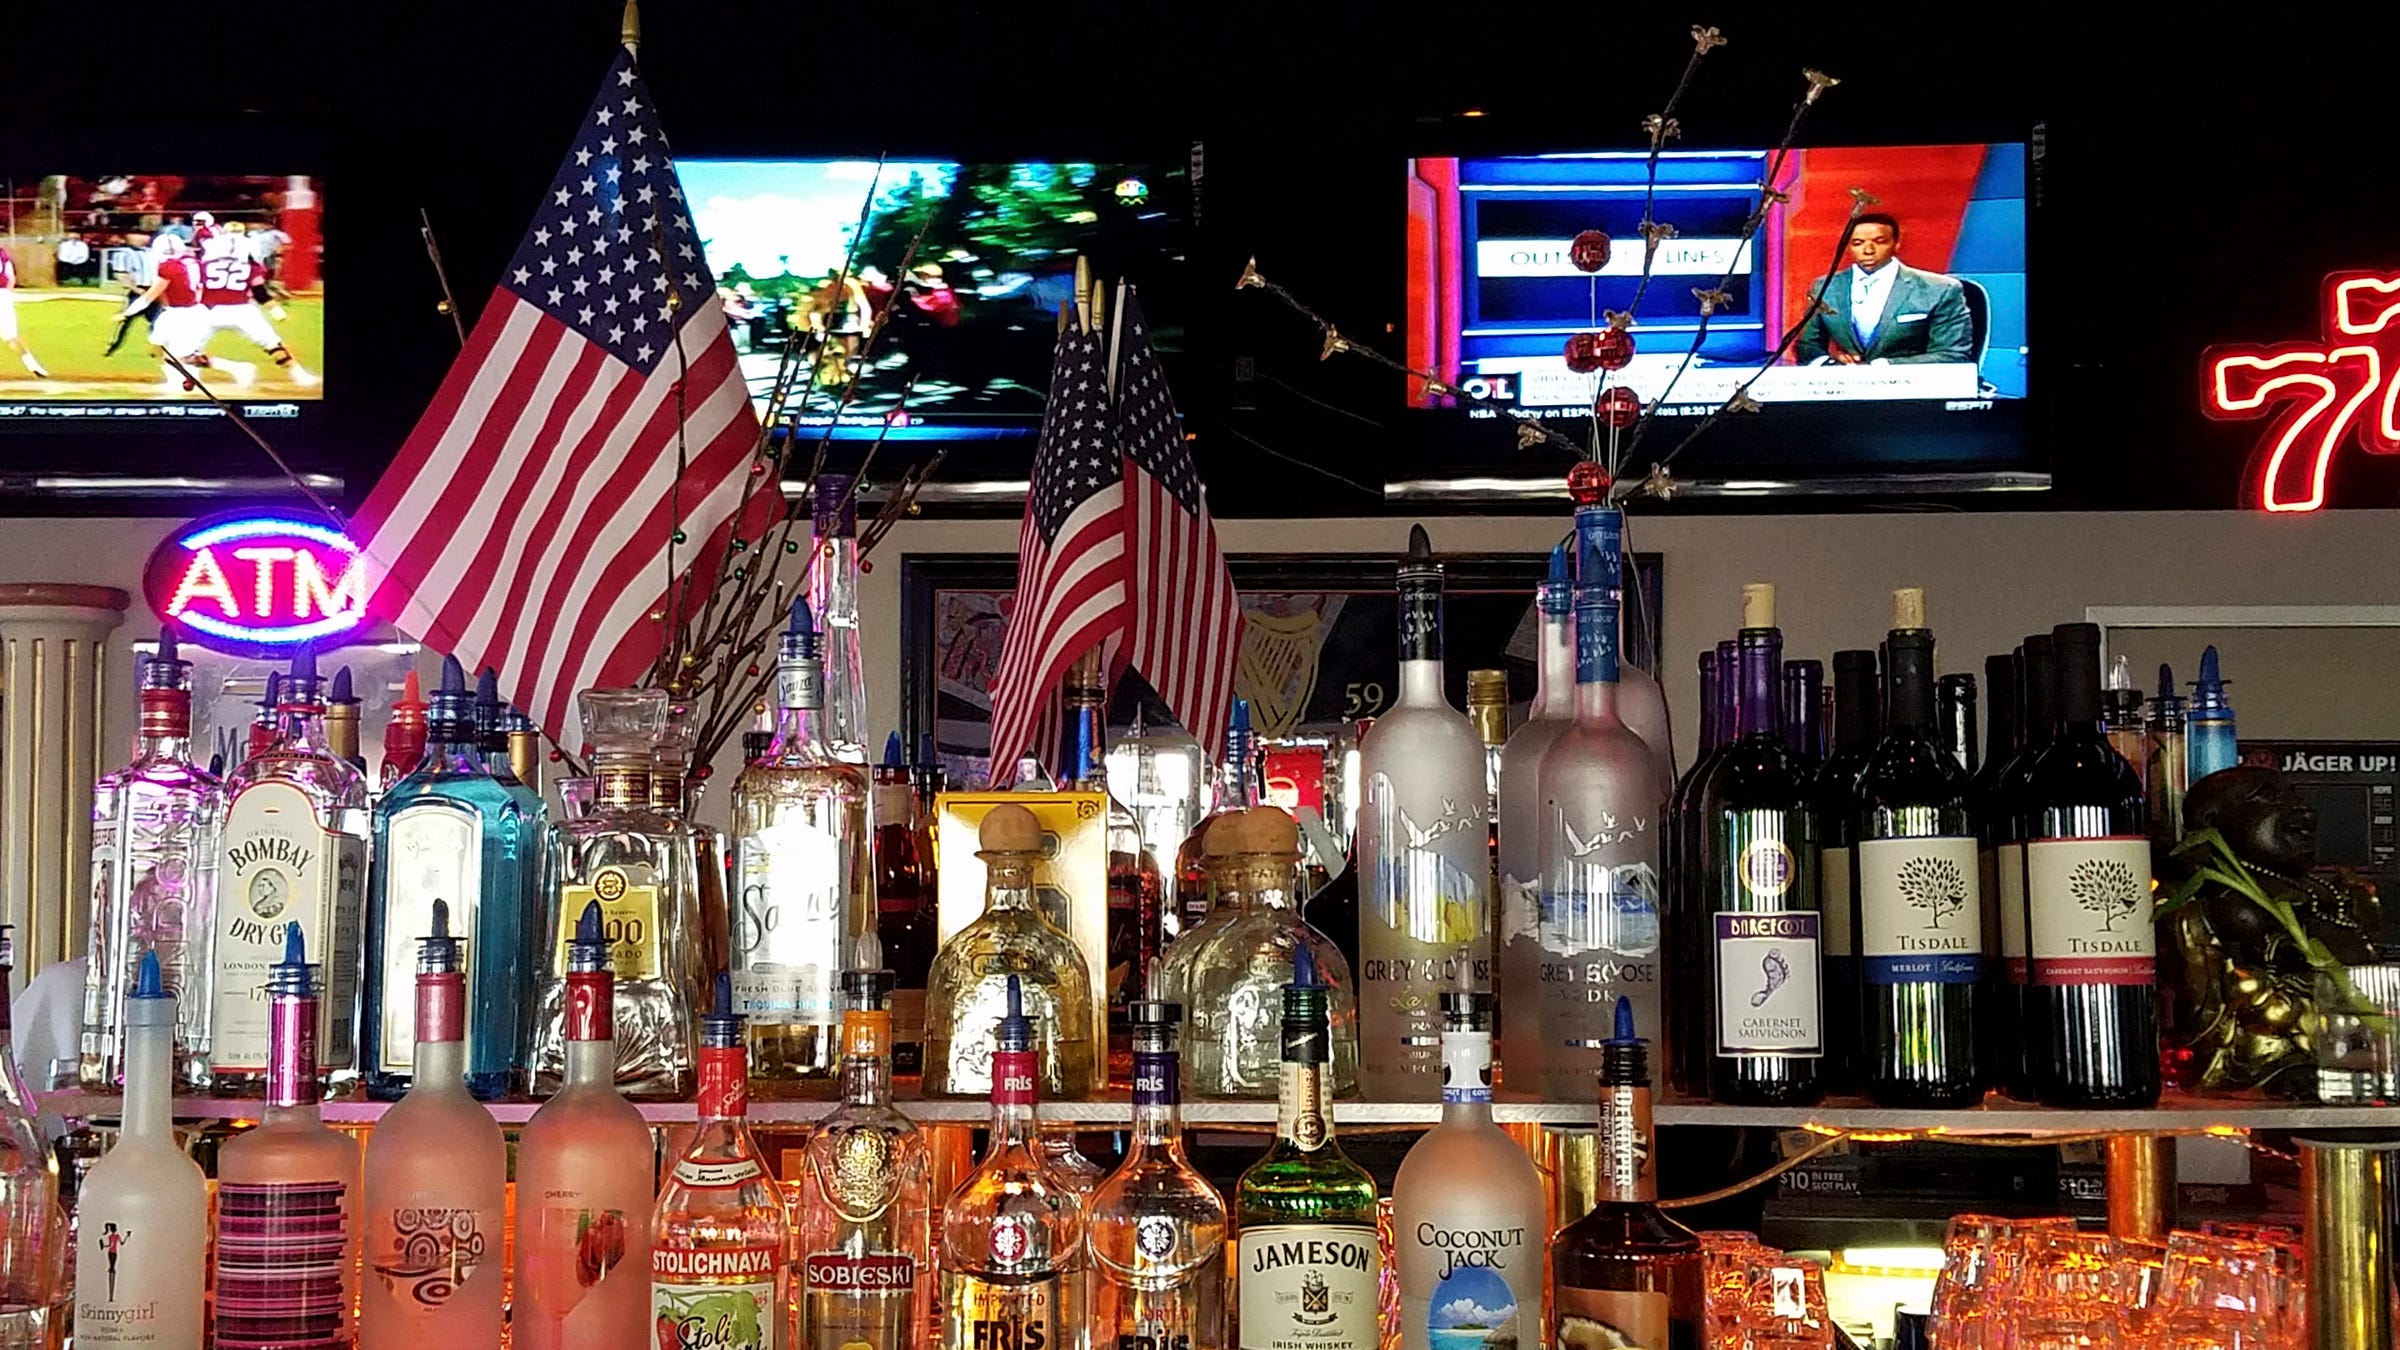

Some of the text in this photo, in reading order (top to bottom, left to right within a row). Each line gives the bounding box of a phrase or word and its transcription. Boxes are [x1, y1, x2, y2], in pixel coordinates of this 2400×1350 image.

[1665, 250, 1724, 264] LINES
[205, 261, 250, 291] 52
[1469, 408, 1498, 420] NBA
[1545, 407, 1560, 418] on
[1944, 400, 1994, 411] ESPN
[164, 547, 367, 618] ATM
[1343, 683, 1384, 715] 59
[2281, 751, 2397, 773] JÄGER UP!
[227, 837, 316, 877] BOMBAY
[228, 917, 268, 946] DRY
[1731, 918, 1808, 936] BAREFOOT
[223, 962, 266, 971] LONDON
[1365, 959, 1416, 982] GREY
[1540, 963, 1576, 982] GREY
[1891, 963, 1932, 972] MERLOT
[734, 985, 768, 993] FRESH
[1742, 1017, 1801, 1029] CABERNET
[1738, 1028, 1807, 1039] SAUVIGNON
[1780, 1171, 1809, 1190] $10
[1823, 1171, 1845, 1181] FREE
[1835, 1181, 1858, 1191] PLAY
[544, 1190, 582, 1200] CHERRY
[652, 1249, 772, 1276] STOLICHNAYA
[1253, 1241, 1369, 1274] JAMESON
[808, 1263, 911, 1287] SOBIESKI
[80, 1301, 156, 1324] Skinnygirl
[676, 1313, 732, 1350] Stoli
[1272, 1340, 1354, 1350] IRISH WHISKEY
